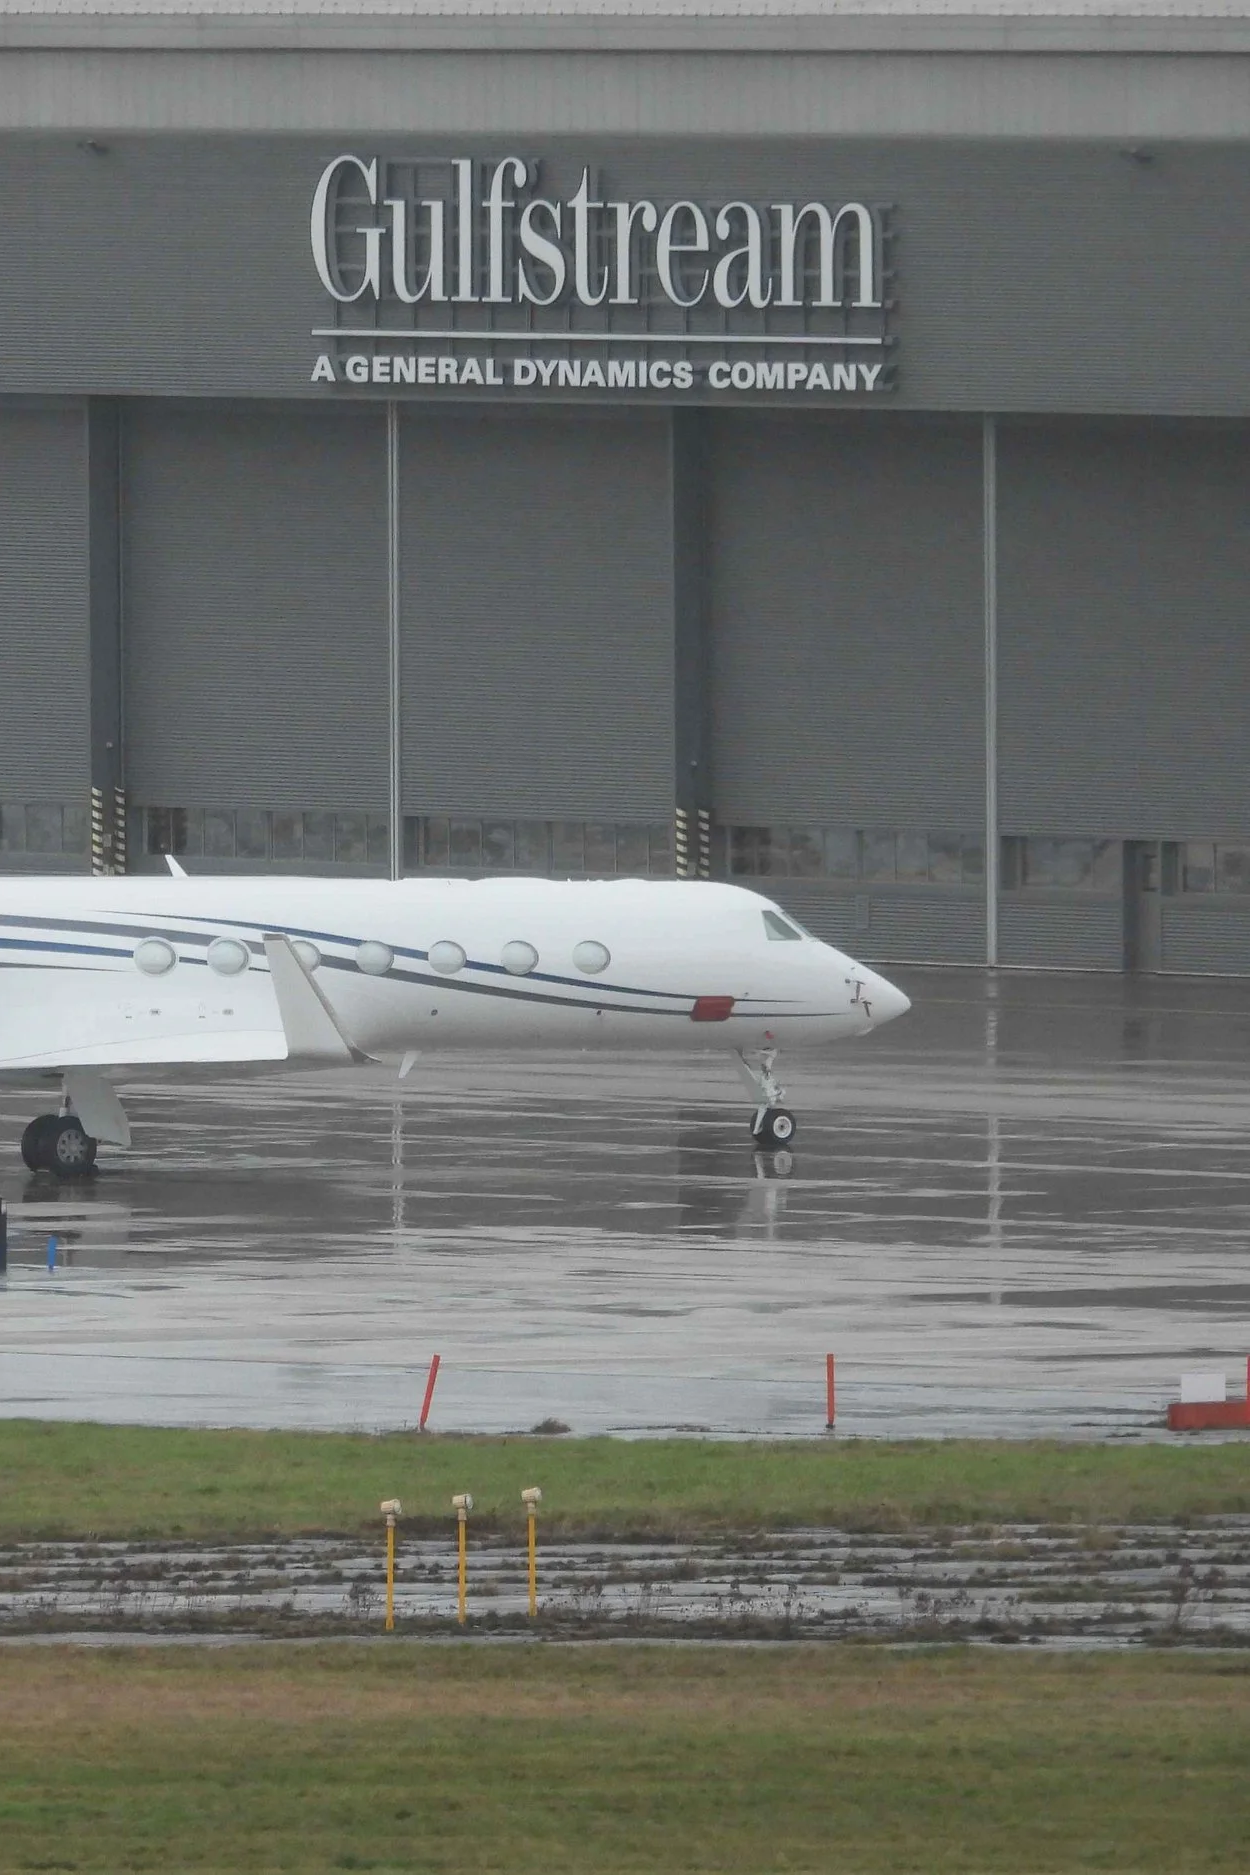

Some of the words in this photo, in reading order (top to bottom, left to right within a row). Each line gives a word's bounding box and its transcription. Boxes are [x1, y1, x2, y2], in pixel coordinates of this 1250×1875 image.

[310, 155, 882, 307] Gulfstream
[310, 355, 336, 382] A
[345, 356, 504, 386] GENERAL
[513, 358, 694, 389] DYNAMICS
[708, 361, 882, 391] COMPANY
